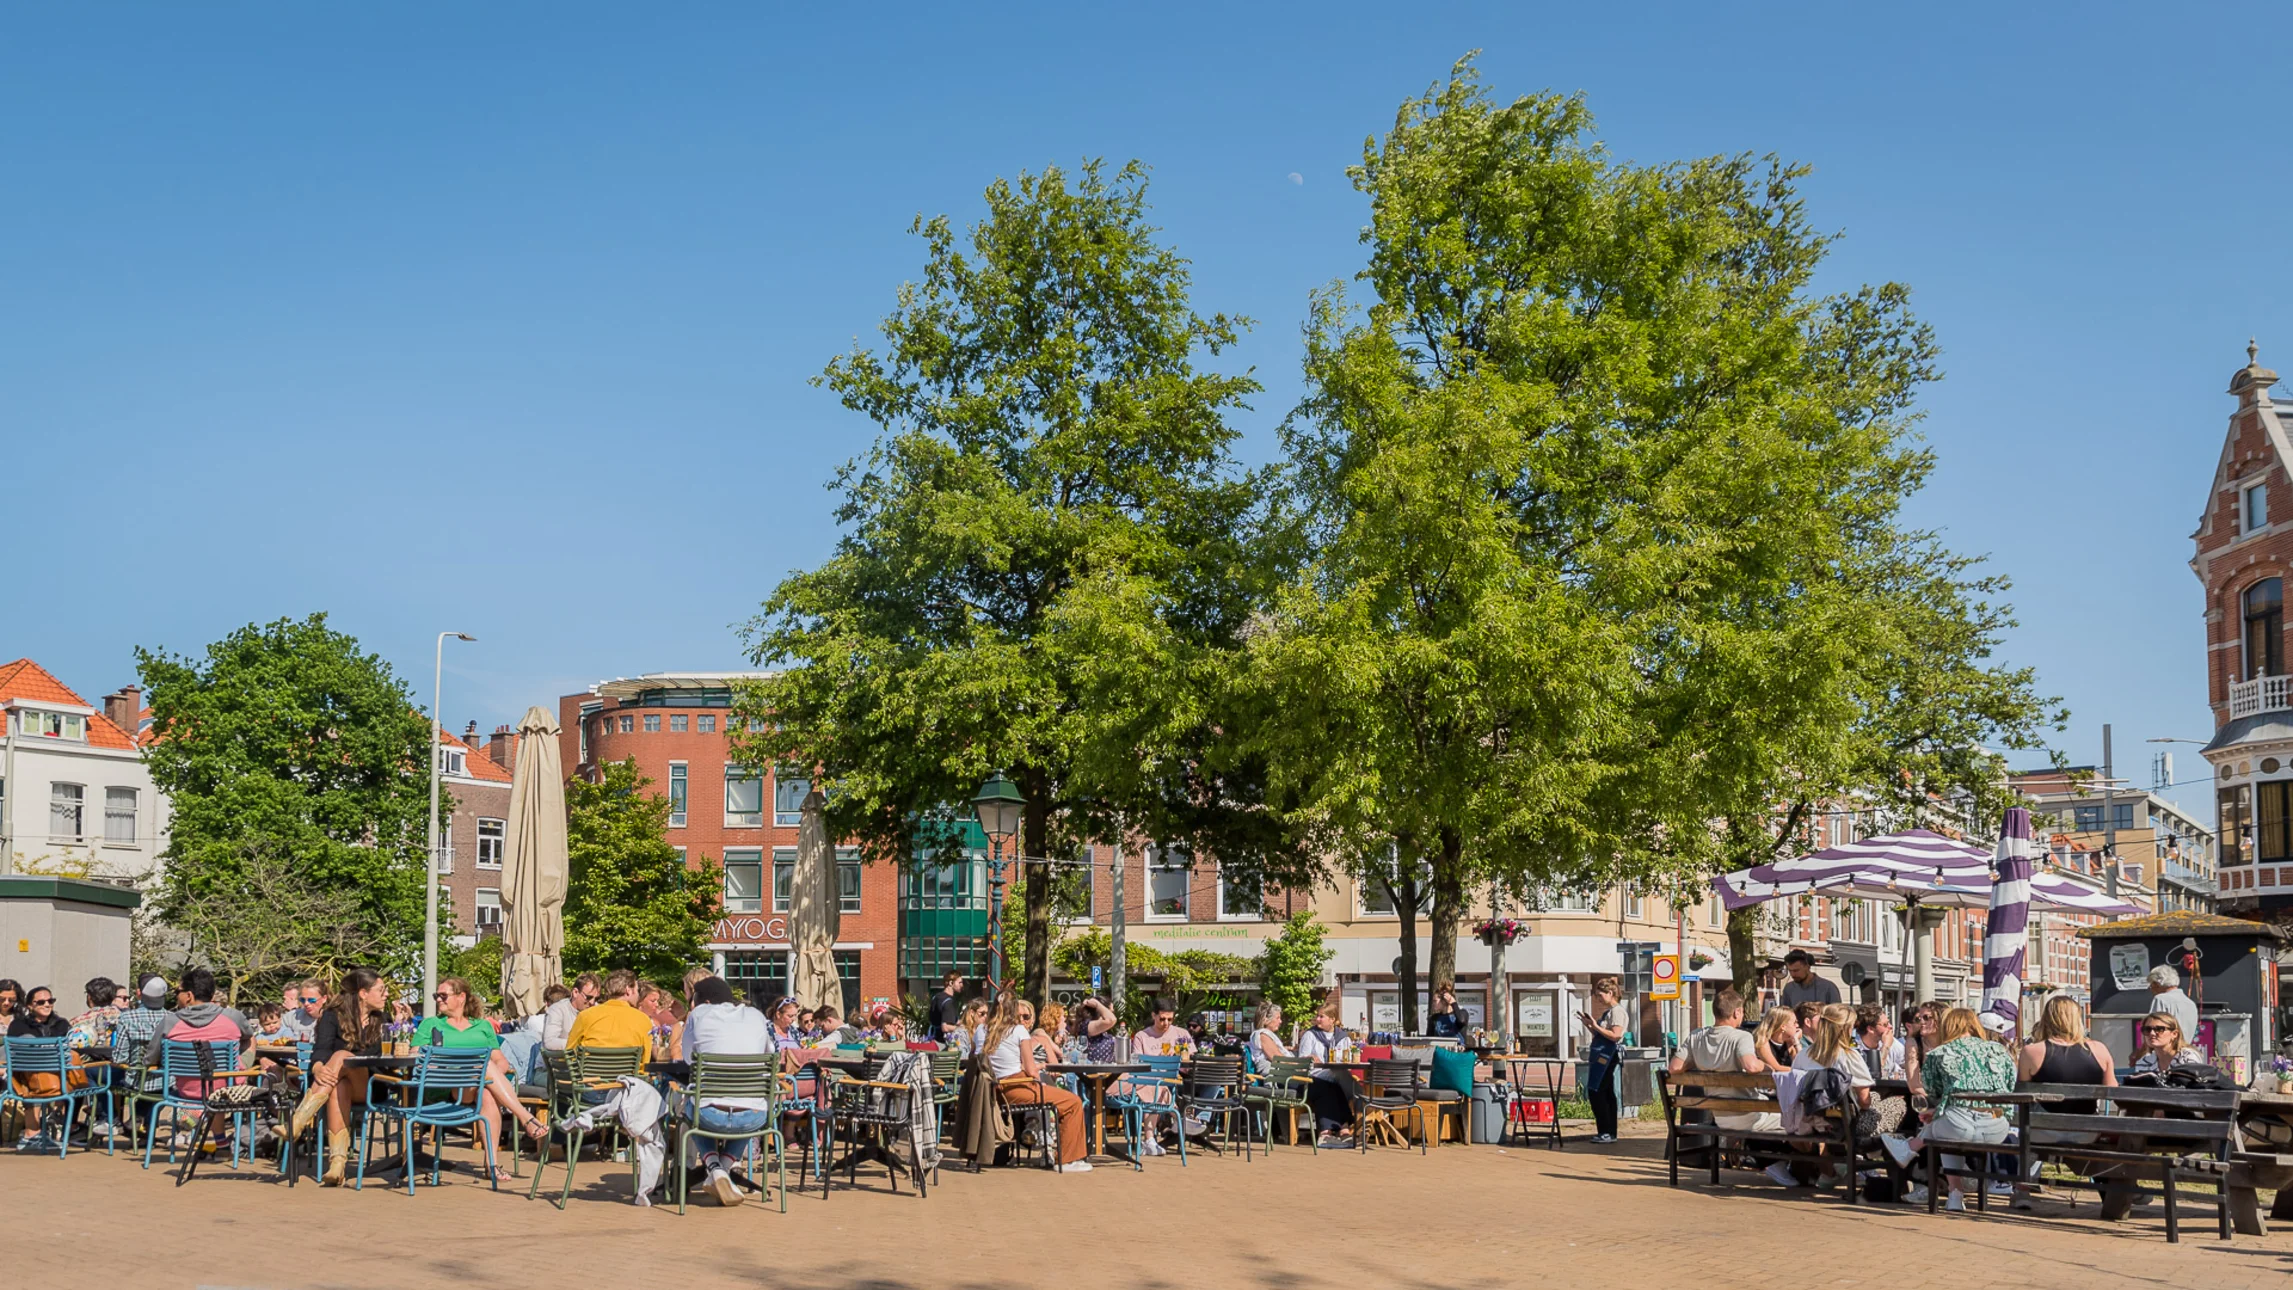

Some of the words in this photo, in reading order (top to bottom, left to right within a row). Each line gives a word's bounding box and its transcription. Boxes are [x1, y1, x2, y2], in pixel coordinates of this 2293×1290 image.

[711, 918, 787, 939] MYYOG
[1204, 925, 1248, 938] centrum
[1094, 968, 1100, 979] P
[1204, 991, 1249, 1011] Wajid
